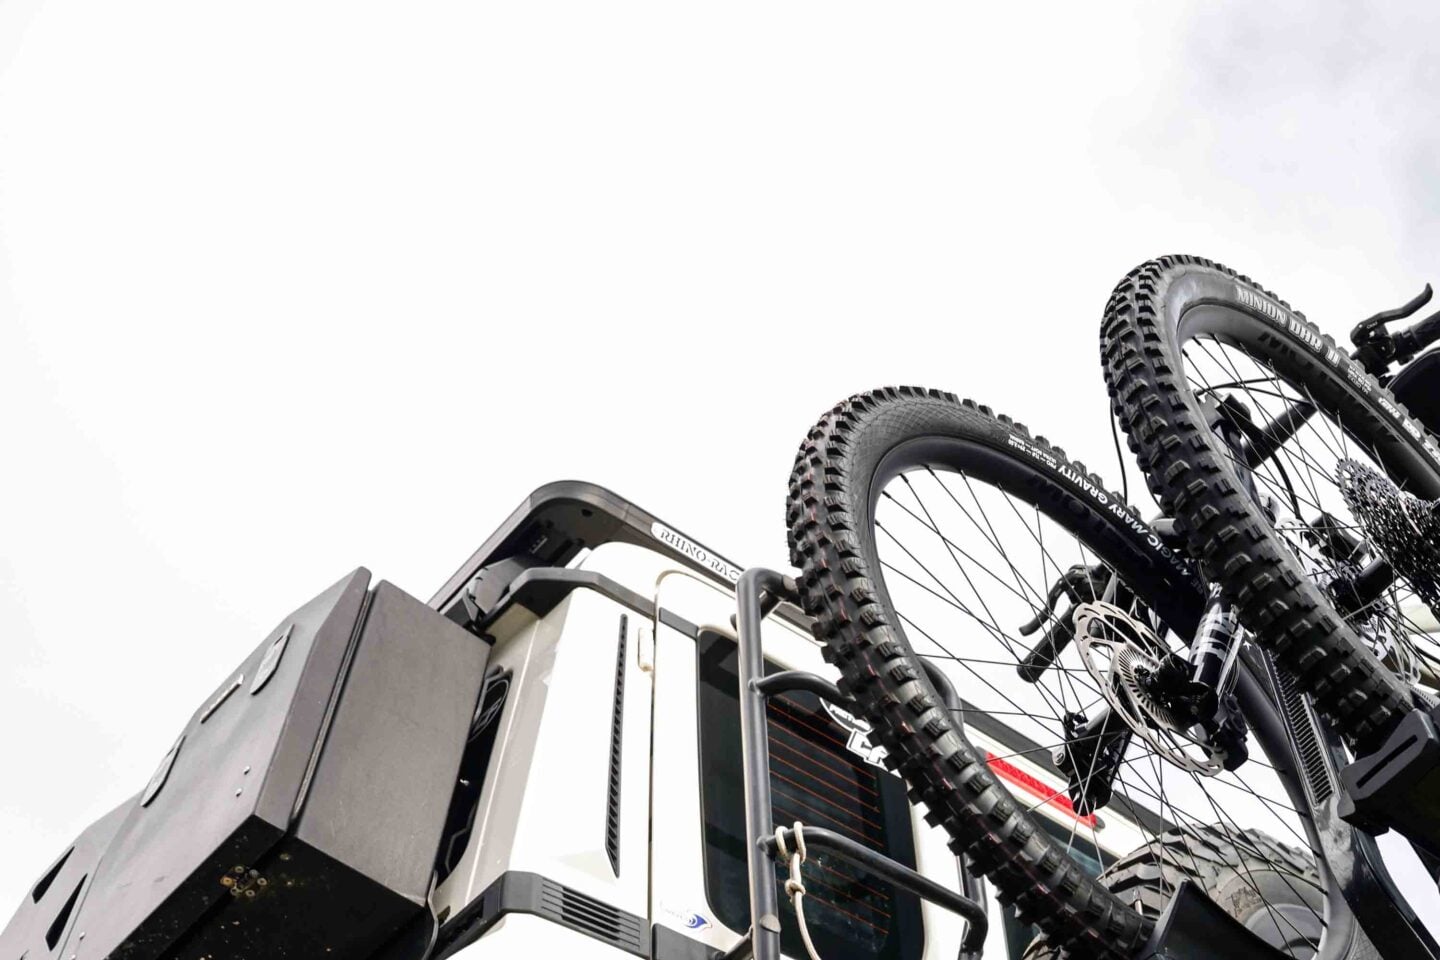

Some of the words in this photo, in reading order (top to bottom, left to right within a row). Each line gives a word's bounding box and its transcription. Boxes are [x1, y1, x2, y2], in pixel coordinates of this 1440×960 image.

[1236, 286, 1287, 328] MINION
[1289, 316, 1323, 353] DHR
[1058, 464, 1108, 504] GRAVITY
[1109, 505, 1148, 535] MARY
[660, 528, 740, 582] RHINO-RAC
